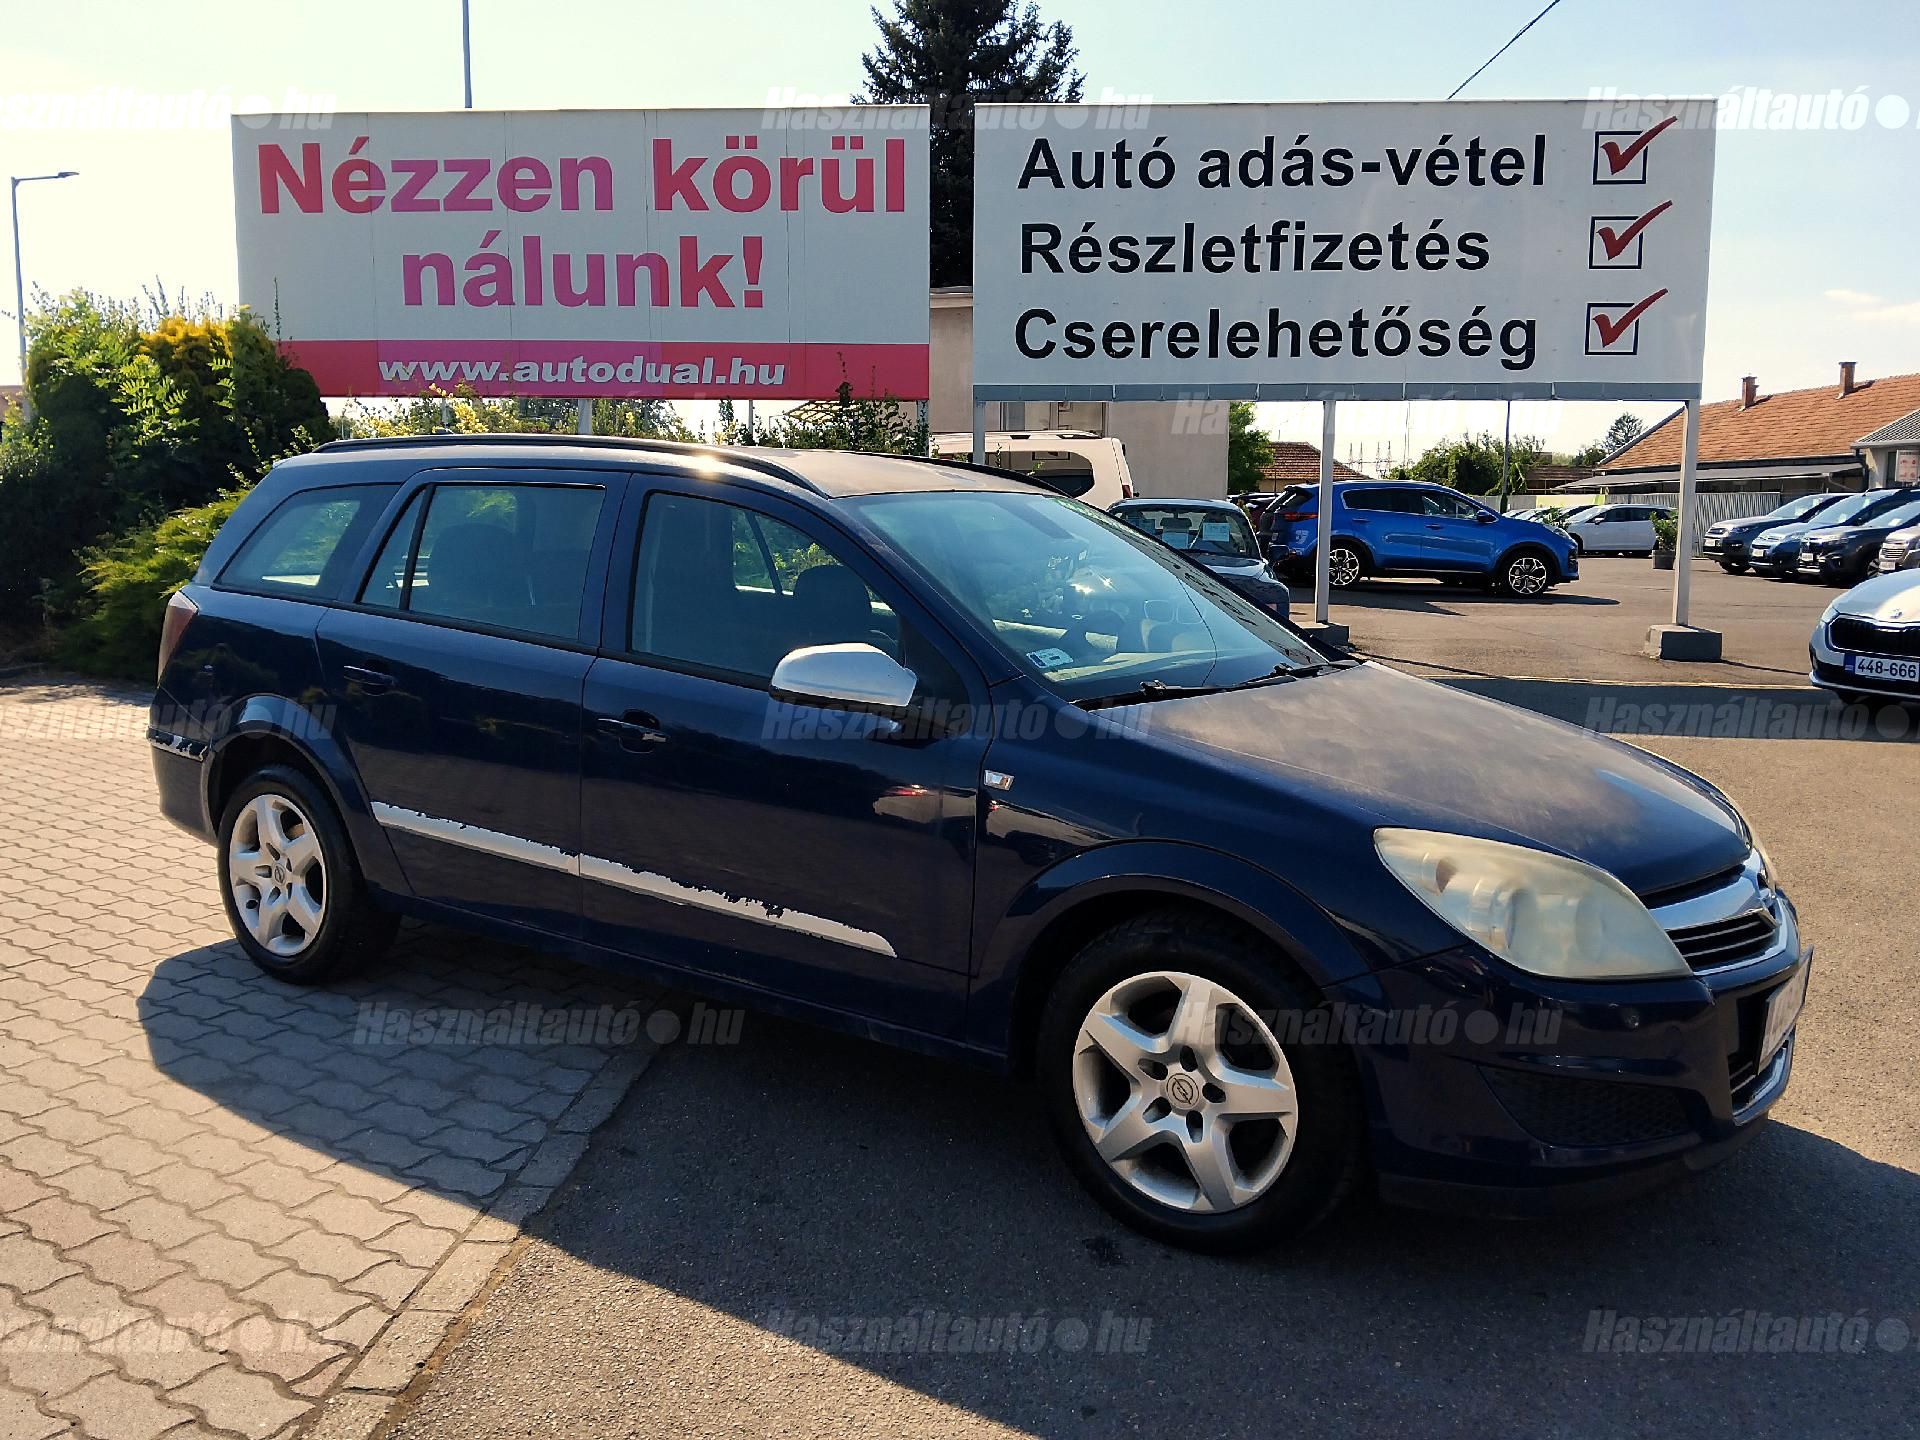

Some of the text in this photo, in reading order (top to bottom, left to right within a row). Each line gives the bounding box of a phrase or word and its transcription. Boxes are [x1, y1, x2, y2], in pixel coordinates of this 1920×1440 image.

[258, 135, 905, 214] Nézzen körül
[1017, 134, 1546, 190] Autó adás-vétel
[402, 229, 763, 308] nálunk!
[1021, 218, 1490, 274] Részletfizetés
[1015, 305, 1537, 371] Cserelehetőség
[378, 355, 786, 386] www.autodual.hu
[1857, 658, 1918, 679] 448-666
